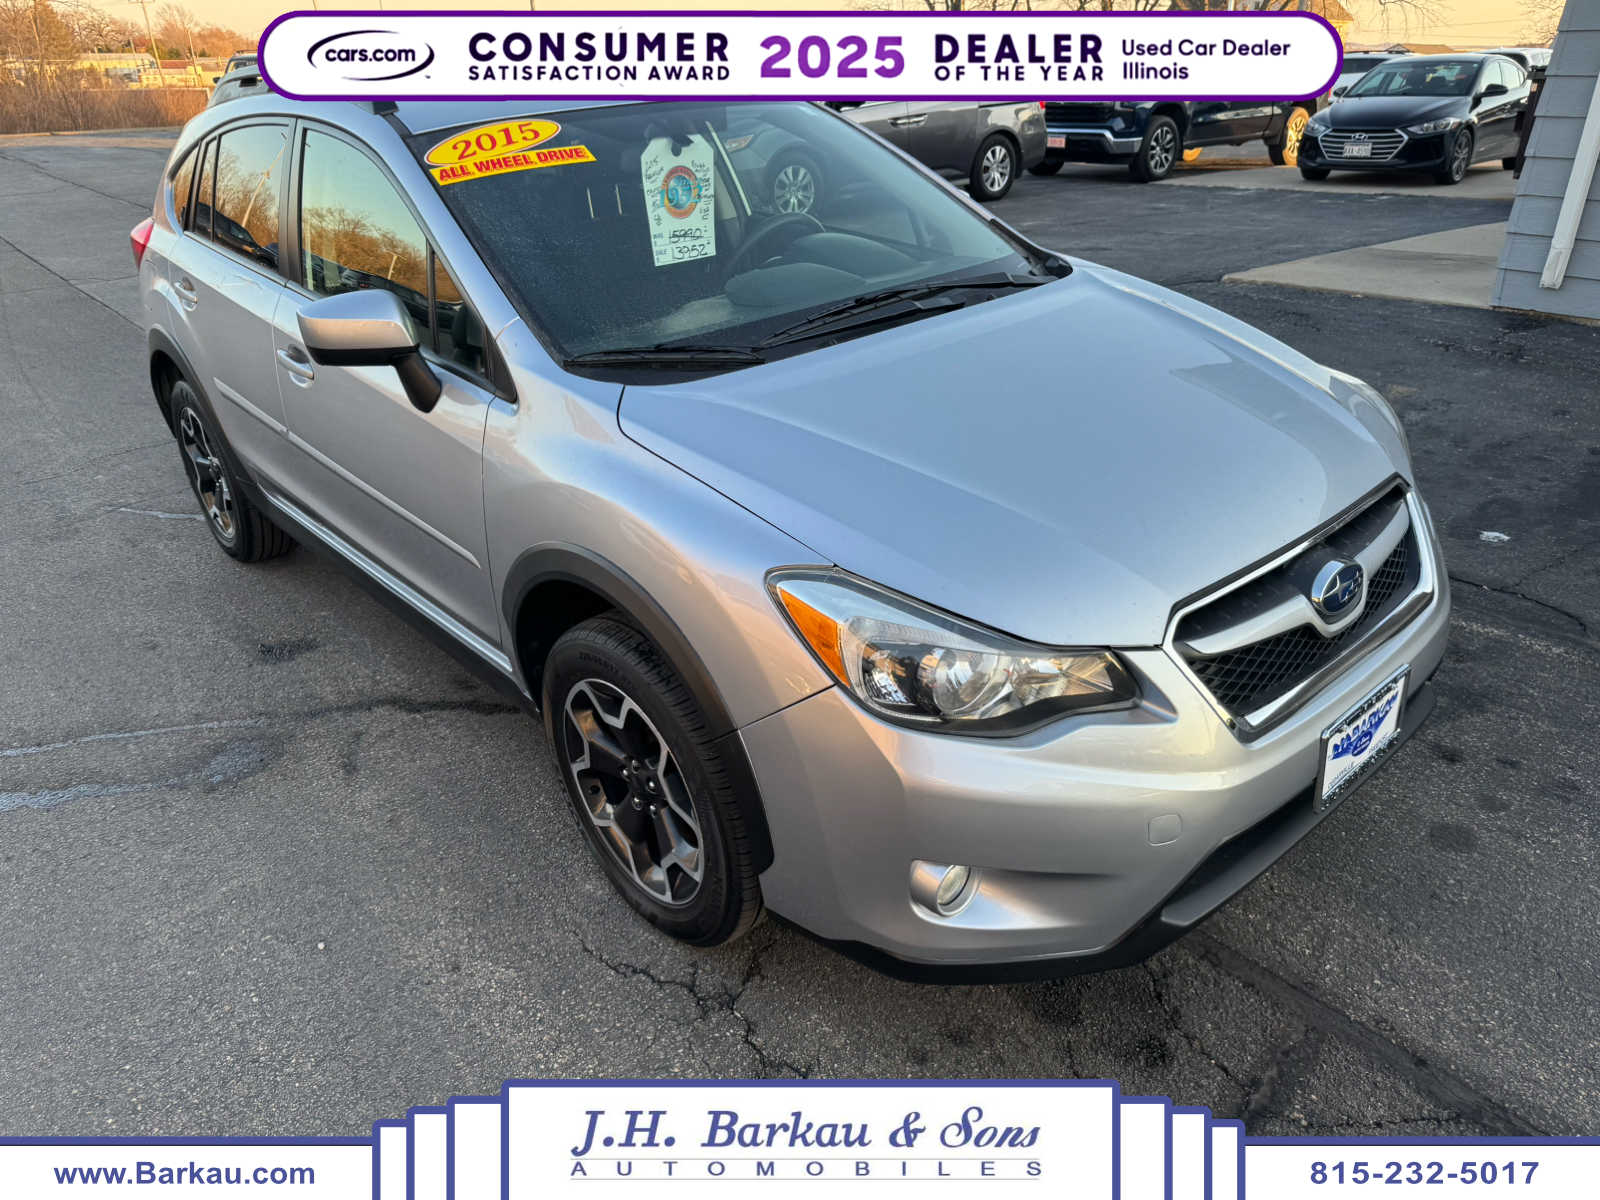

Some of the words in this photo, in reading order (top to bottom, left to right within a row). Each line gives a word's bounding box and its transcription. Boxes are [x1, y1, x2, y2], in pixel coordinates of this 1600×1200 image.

[452, 122, 540, 160] 2015
[439, 166, 472, 182] ALL
[474, 155, 534, 172] WHEEL
[537, 147, 585, 162] DRIVE
